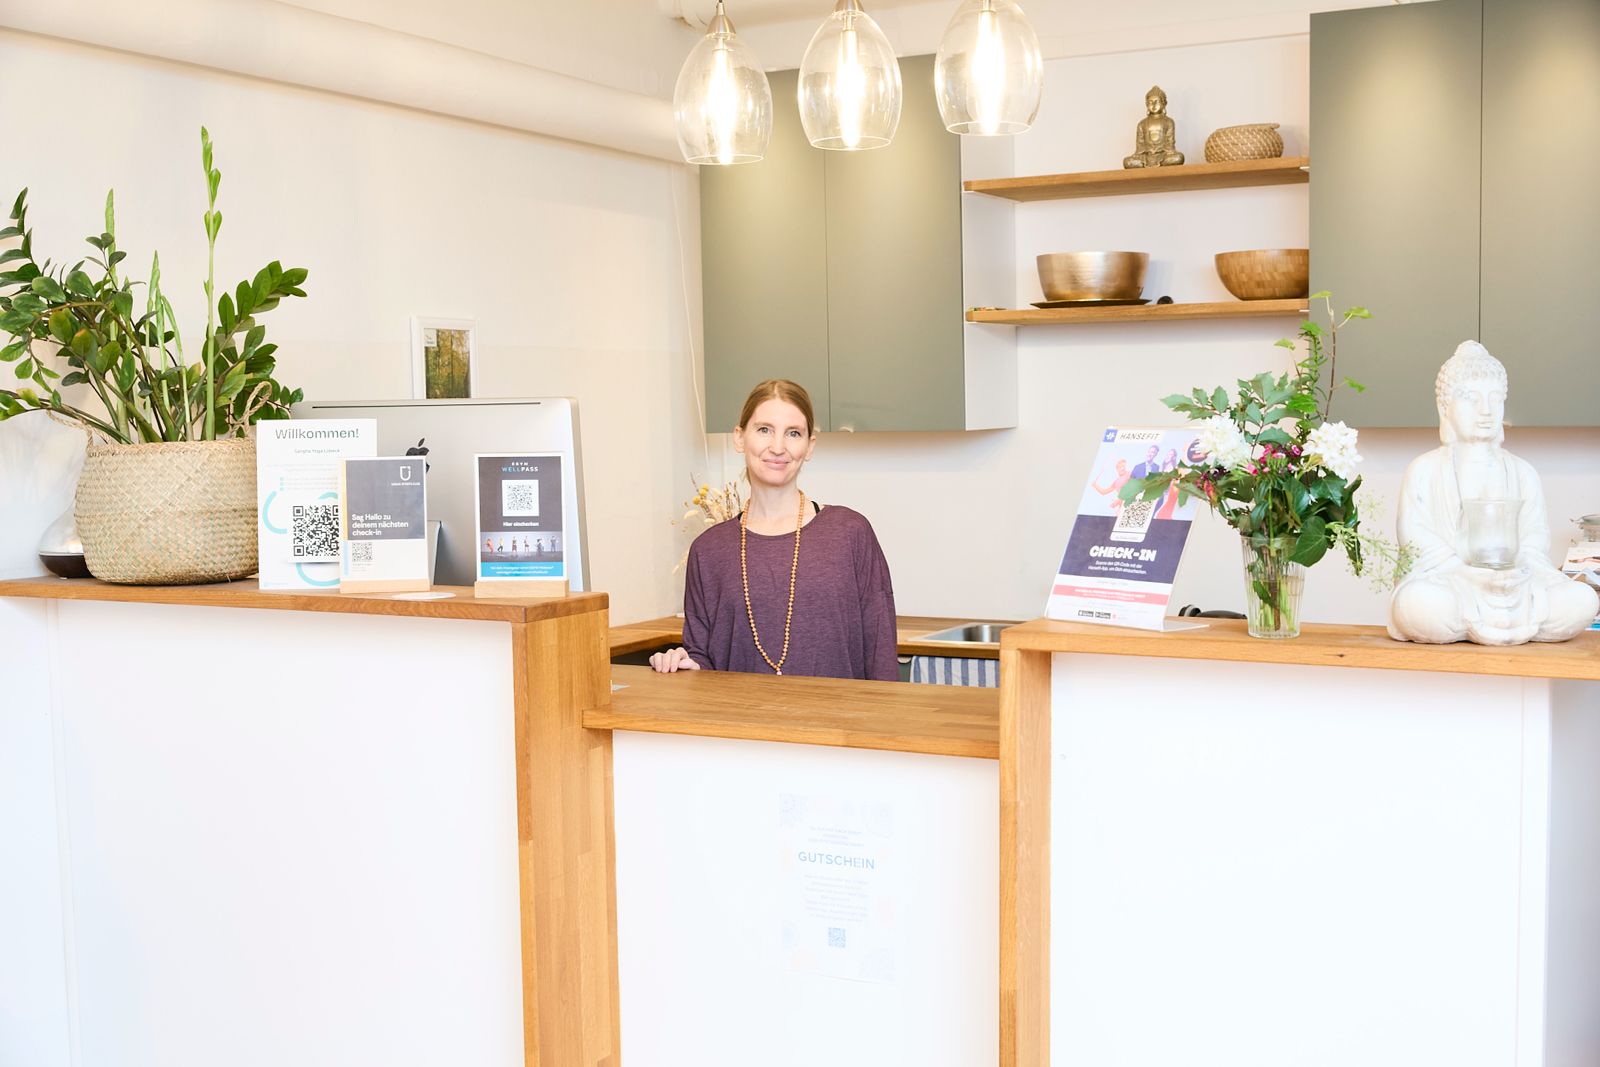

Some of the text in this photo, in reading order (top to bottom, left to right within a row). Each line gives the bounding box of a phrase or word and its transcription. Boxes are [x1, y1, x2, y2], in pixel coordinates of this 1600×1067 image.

[275, 428, 359, 439] Willkommen!
[352, 514, 364, 522] Sag
[1089, 546, 1157, 562] CHECK-IN
[798, 851, 875, 870] GUTSCHEIN
